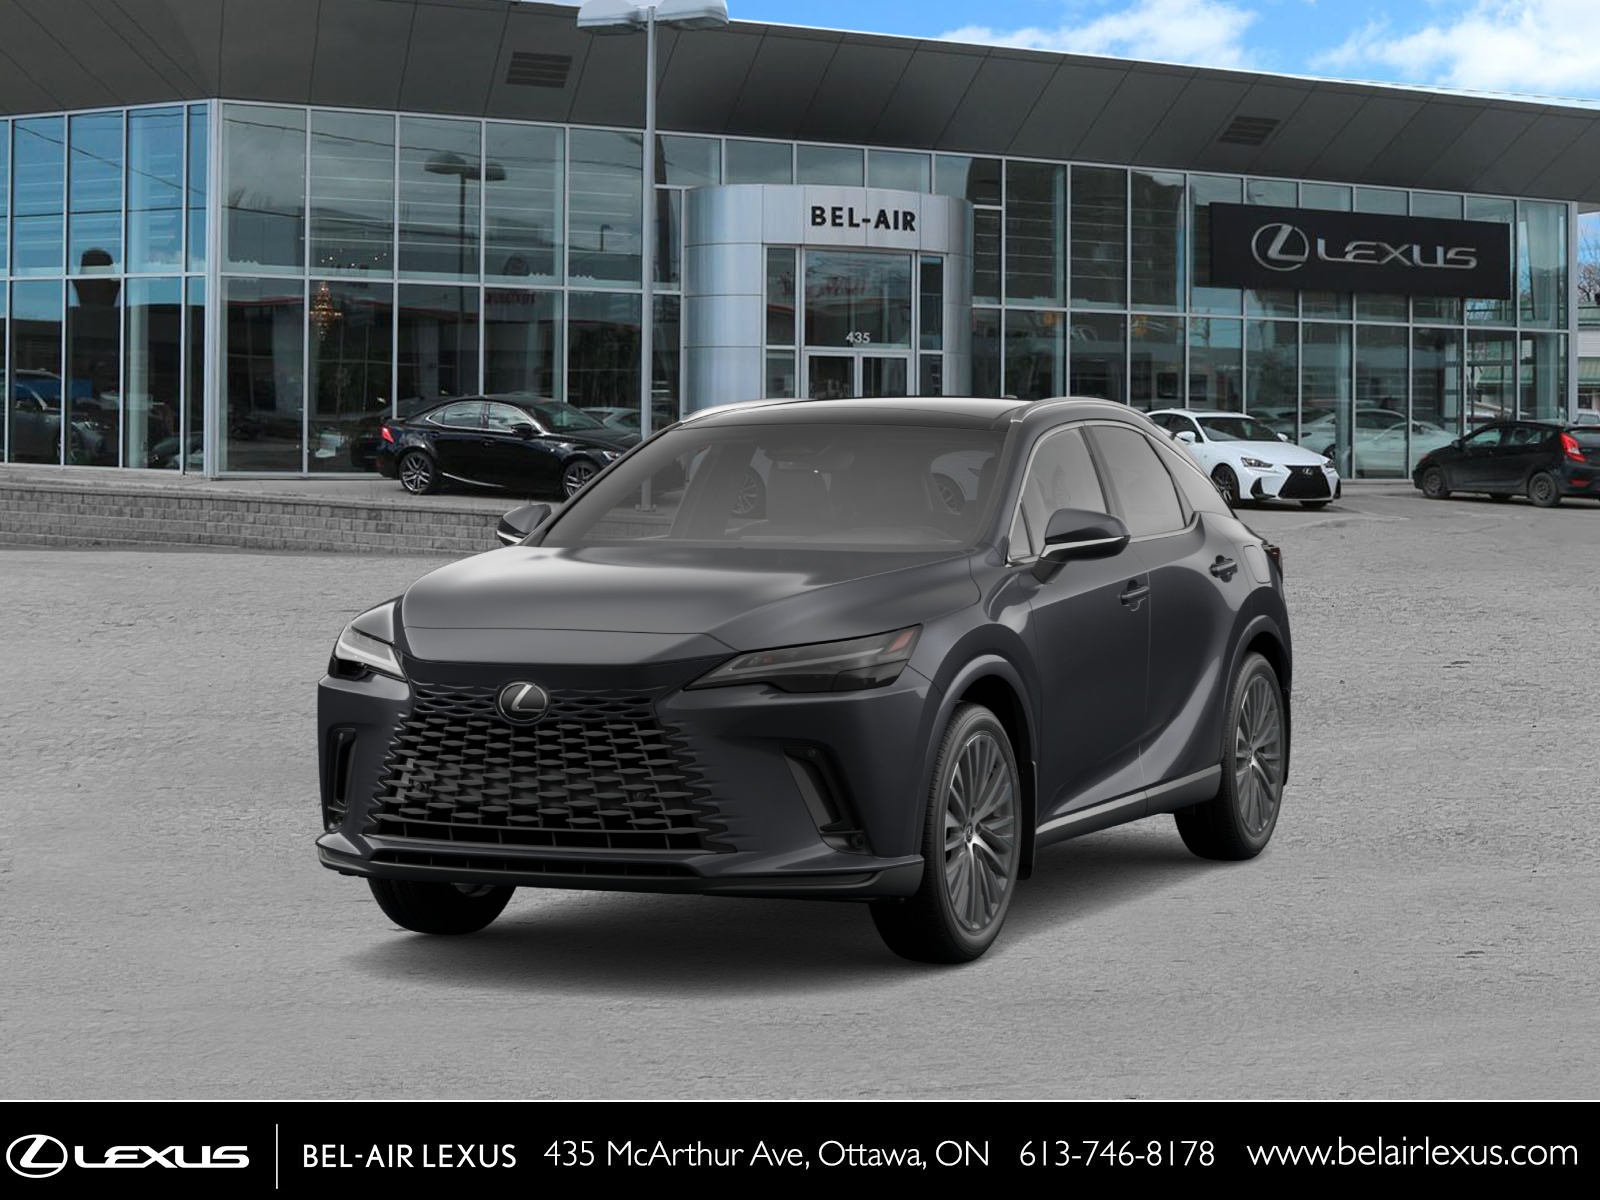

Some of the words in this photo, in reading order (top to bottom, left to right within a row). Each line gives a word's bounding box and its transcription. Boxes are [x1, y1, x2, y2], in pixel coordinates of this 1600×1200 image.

[811, 205, 916, 232] BEL-AIR
[1317, 238, 1477, 269] LEXUS
[846, 331, 871, 345] 435
